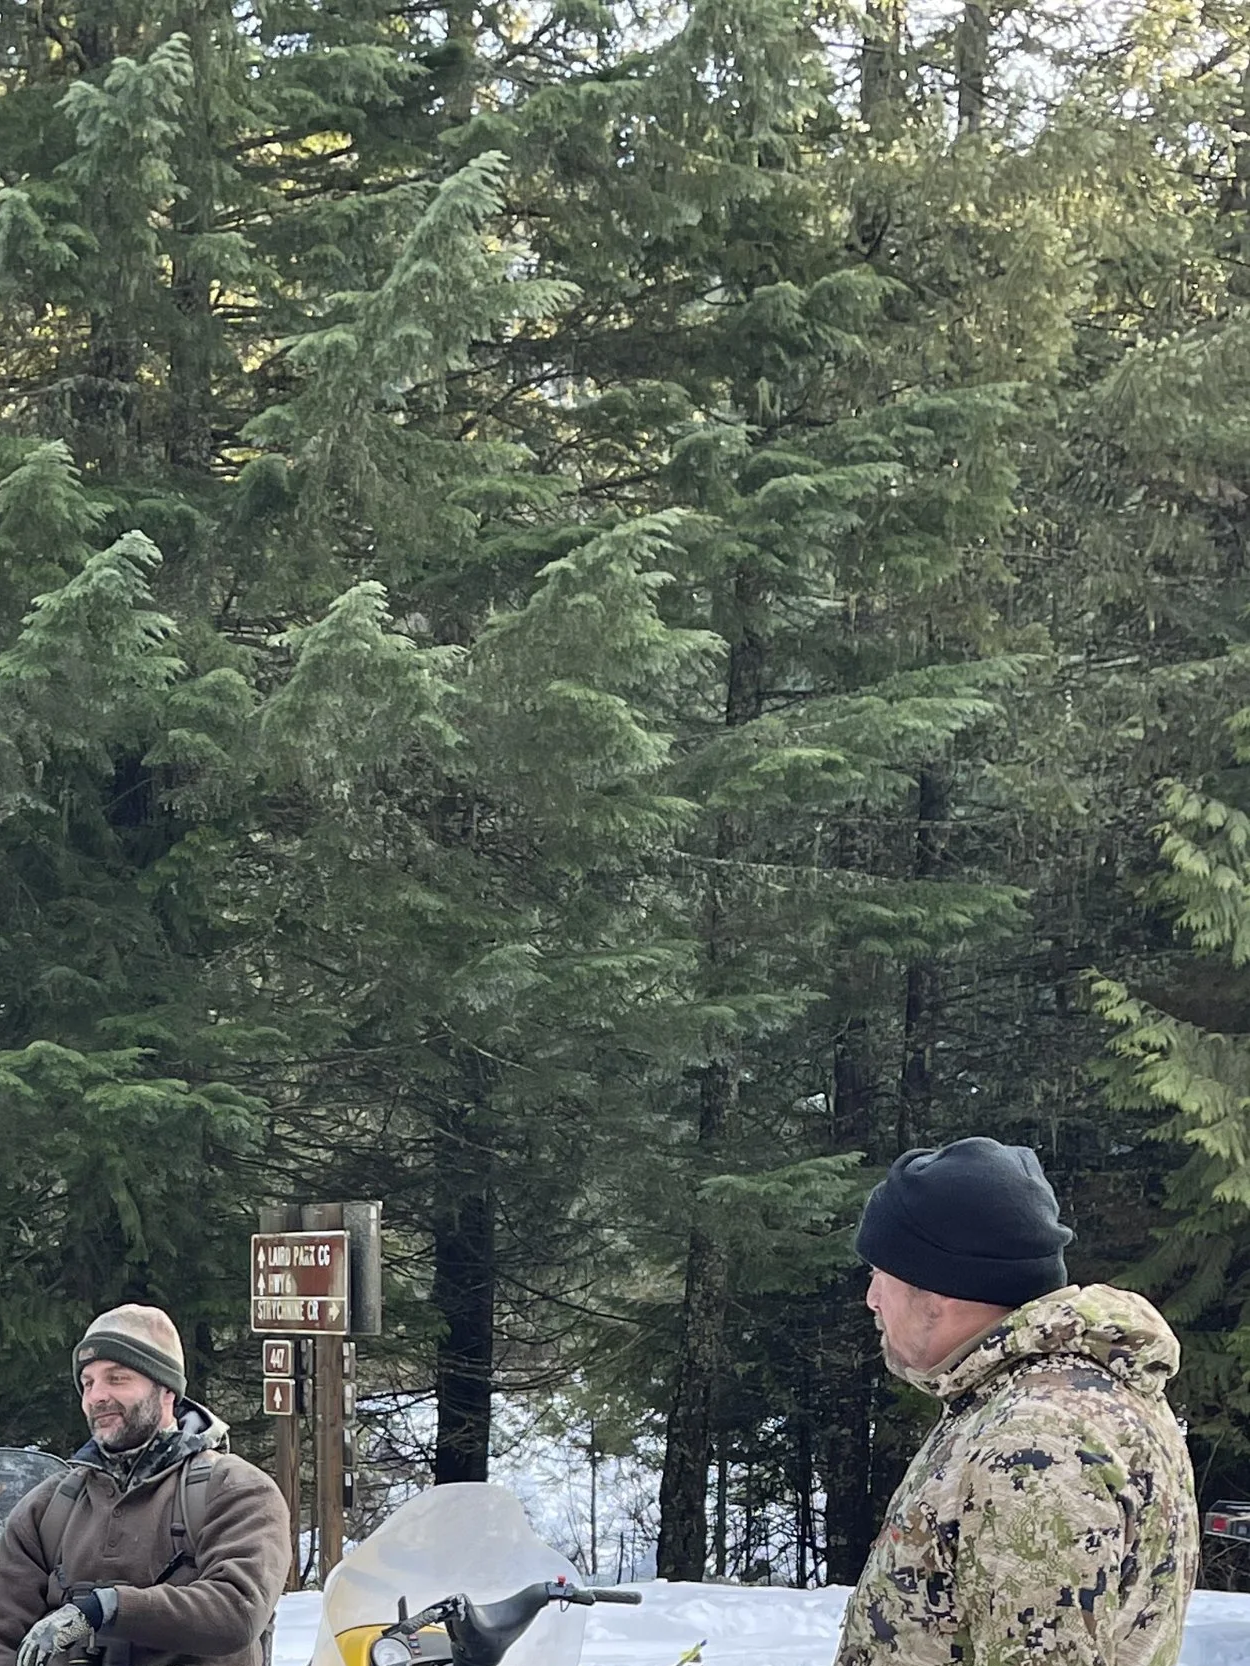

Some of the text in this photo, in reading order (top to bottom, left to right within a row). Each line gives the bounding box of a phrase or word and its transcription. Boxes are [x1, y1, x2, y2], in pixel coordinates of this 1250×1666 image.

[268, 1244, 330, 1267] LAIRD PARK CG
